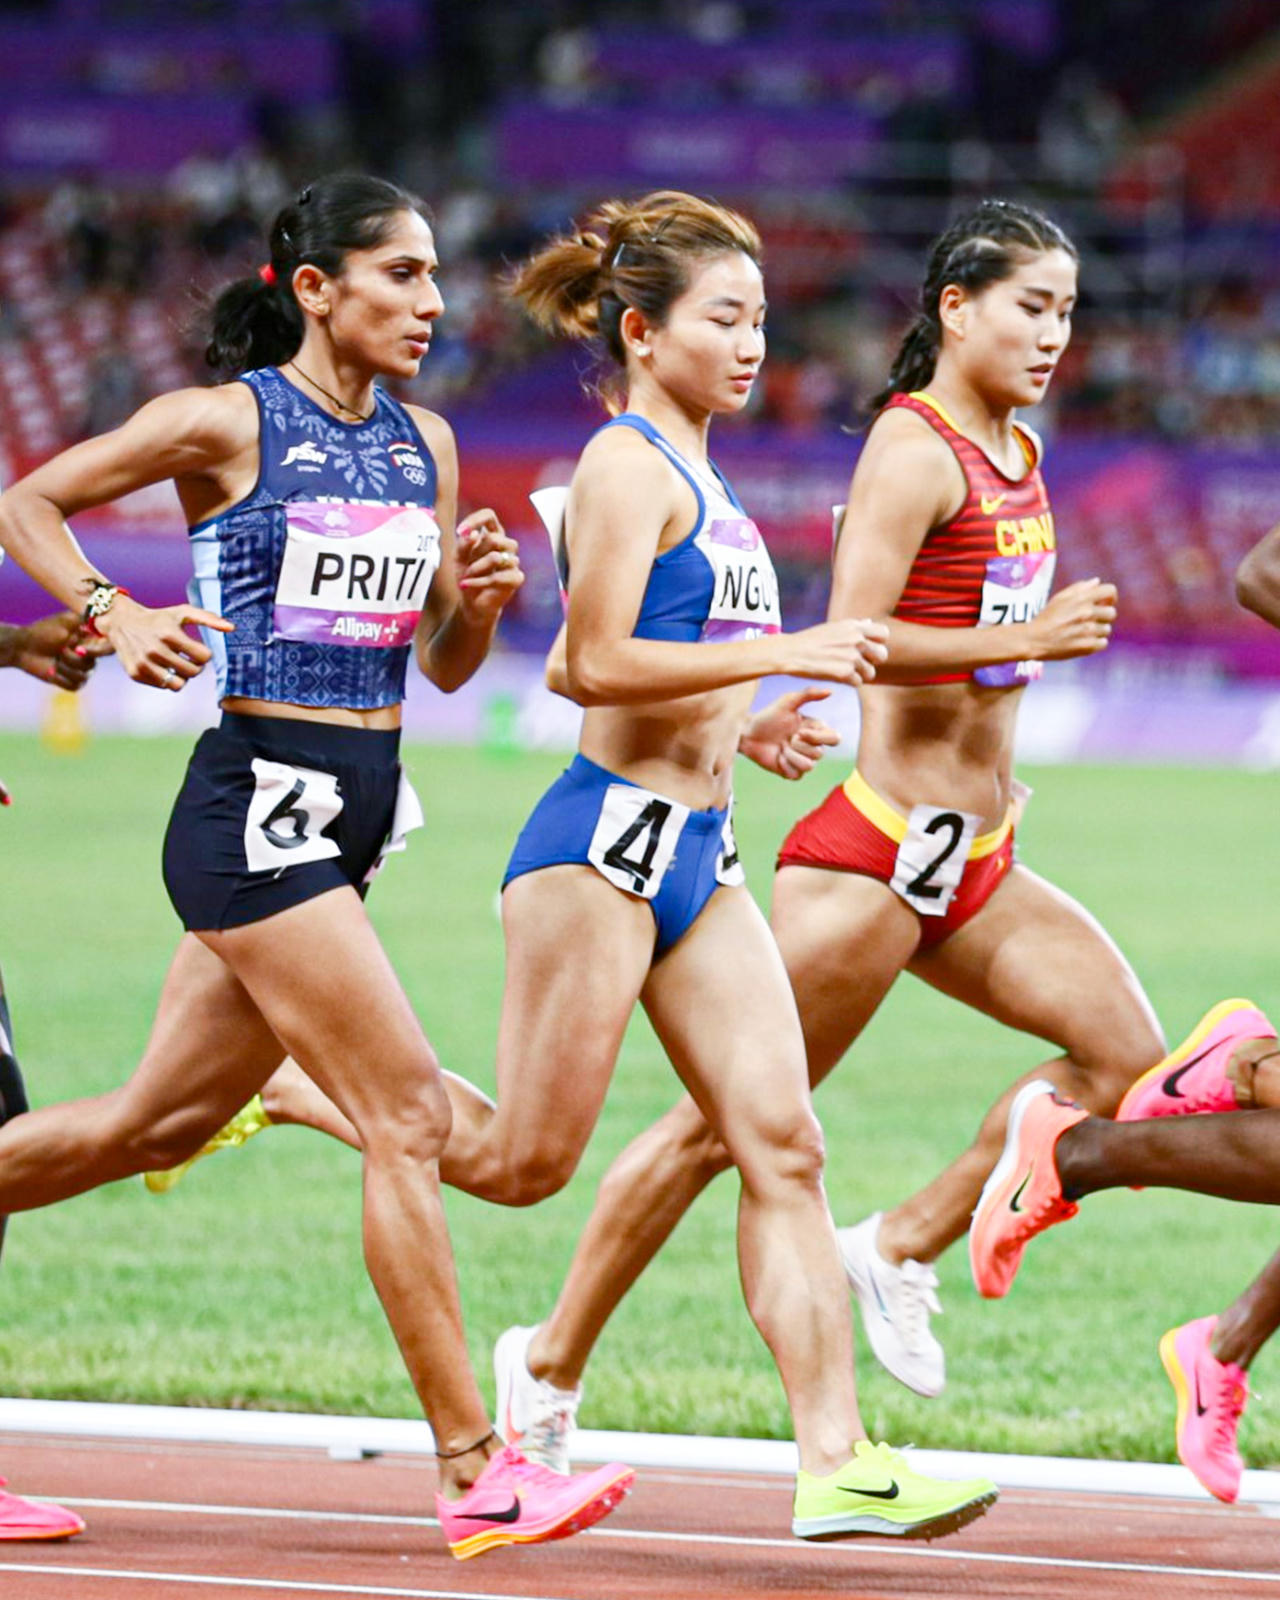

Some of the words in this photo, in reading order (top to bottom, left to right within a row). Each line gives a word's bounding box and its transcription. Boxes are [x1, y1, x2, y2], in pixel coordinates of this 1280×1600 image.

[310, 552, 426, 601] PRITI
[259, 778, 310, 850] 6
[603, 799, 672, 893] 4
[906, 812, 964, 899] 2
